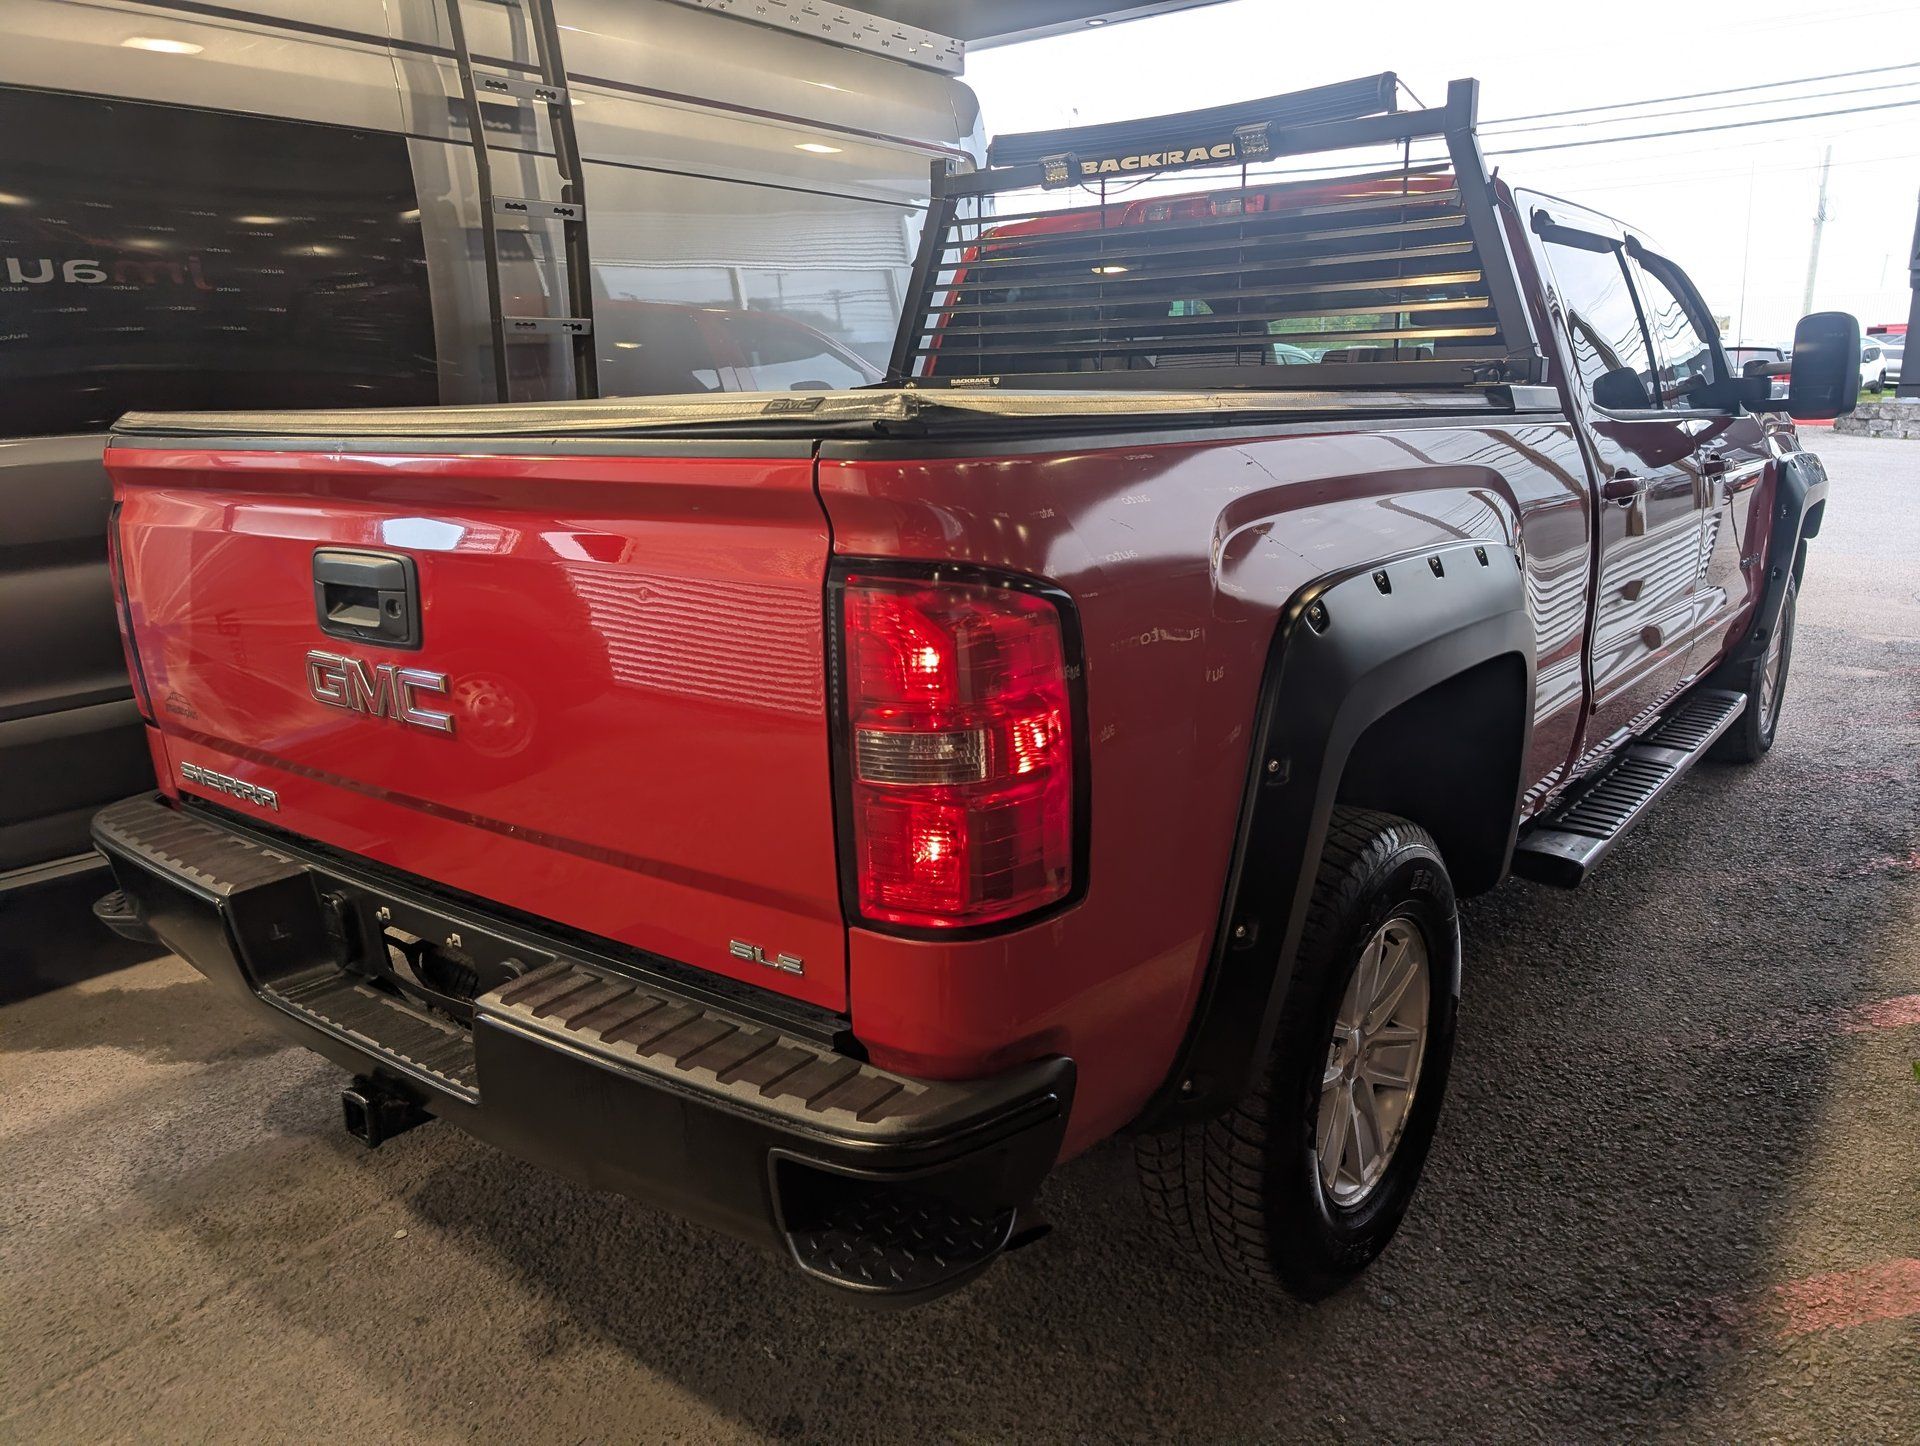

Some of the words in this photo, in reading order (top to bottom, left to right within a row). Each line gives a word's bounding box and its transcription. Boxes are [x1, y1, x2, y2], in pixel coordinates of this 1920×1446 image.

[767, 399, 819, 410] GMC
[305, 649, 455, 733] GMC
[180, 760, 280, 813] SIERRA
[729, 939, 804, 976] SLE
